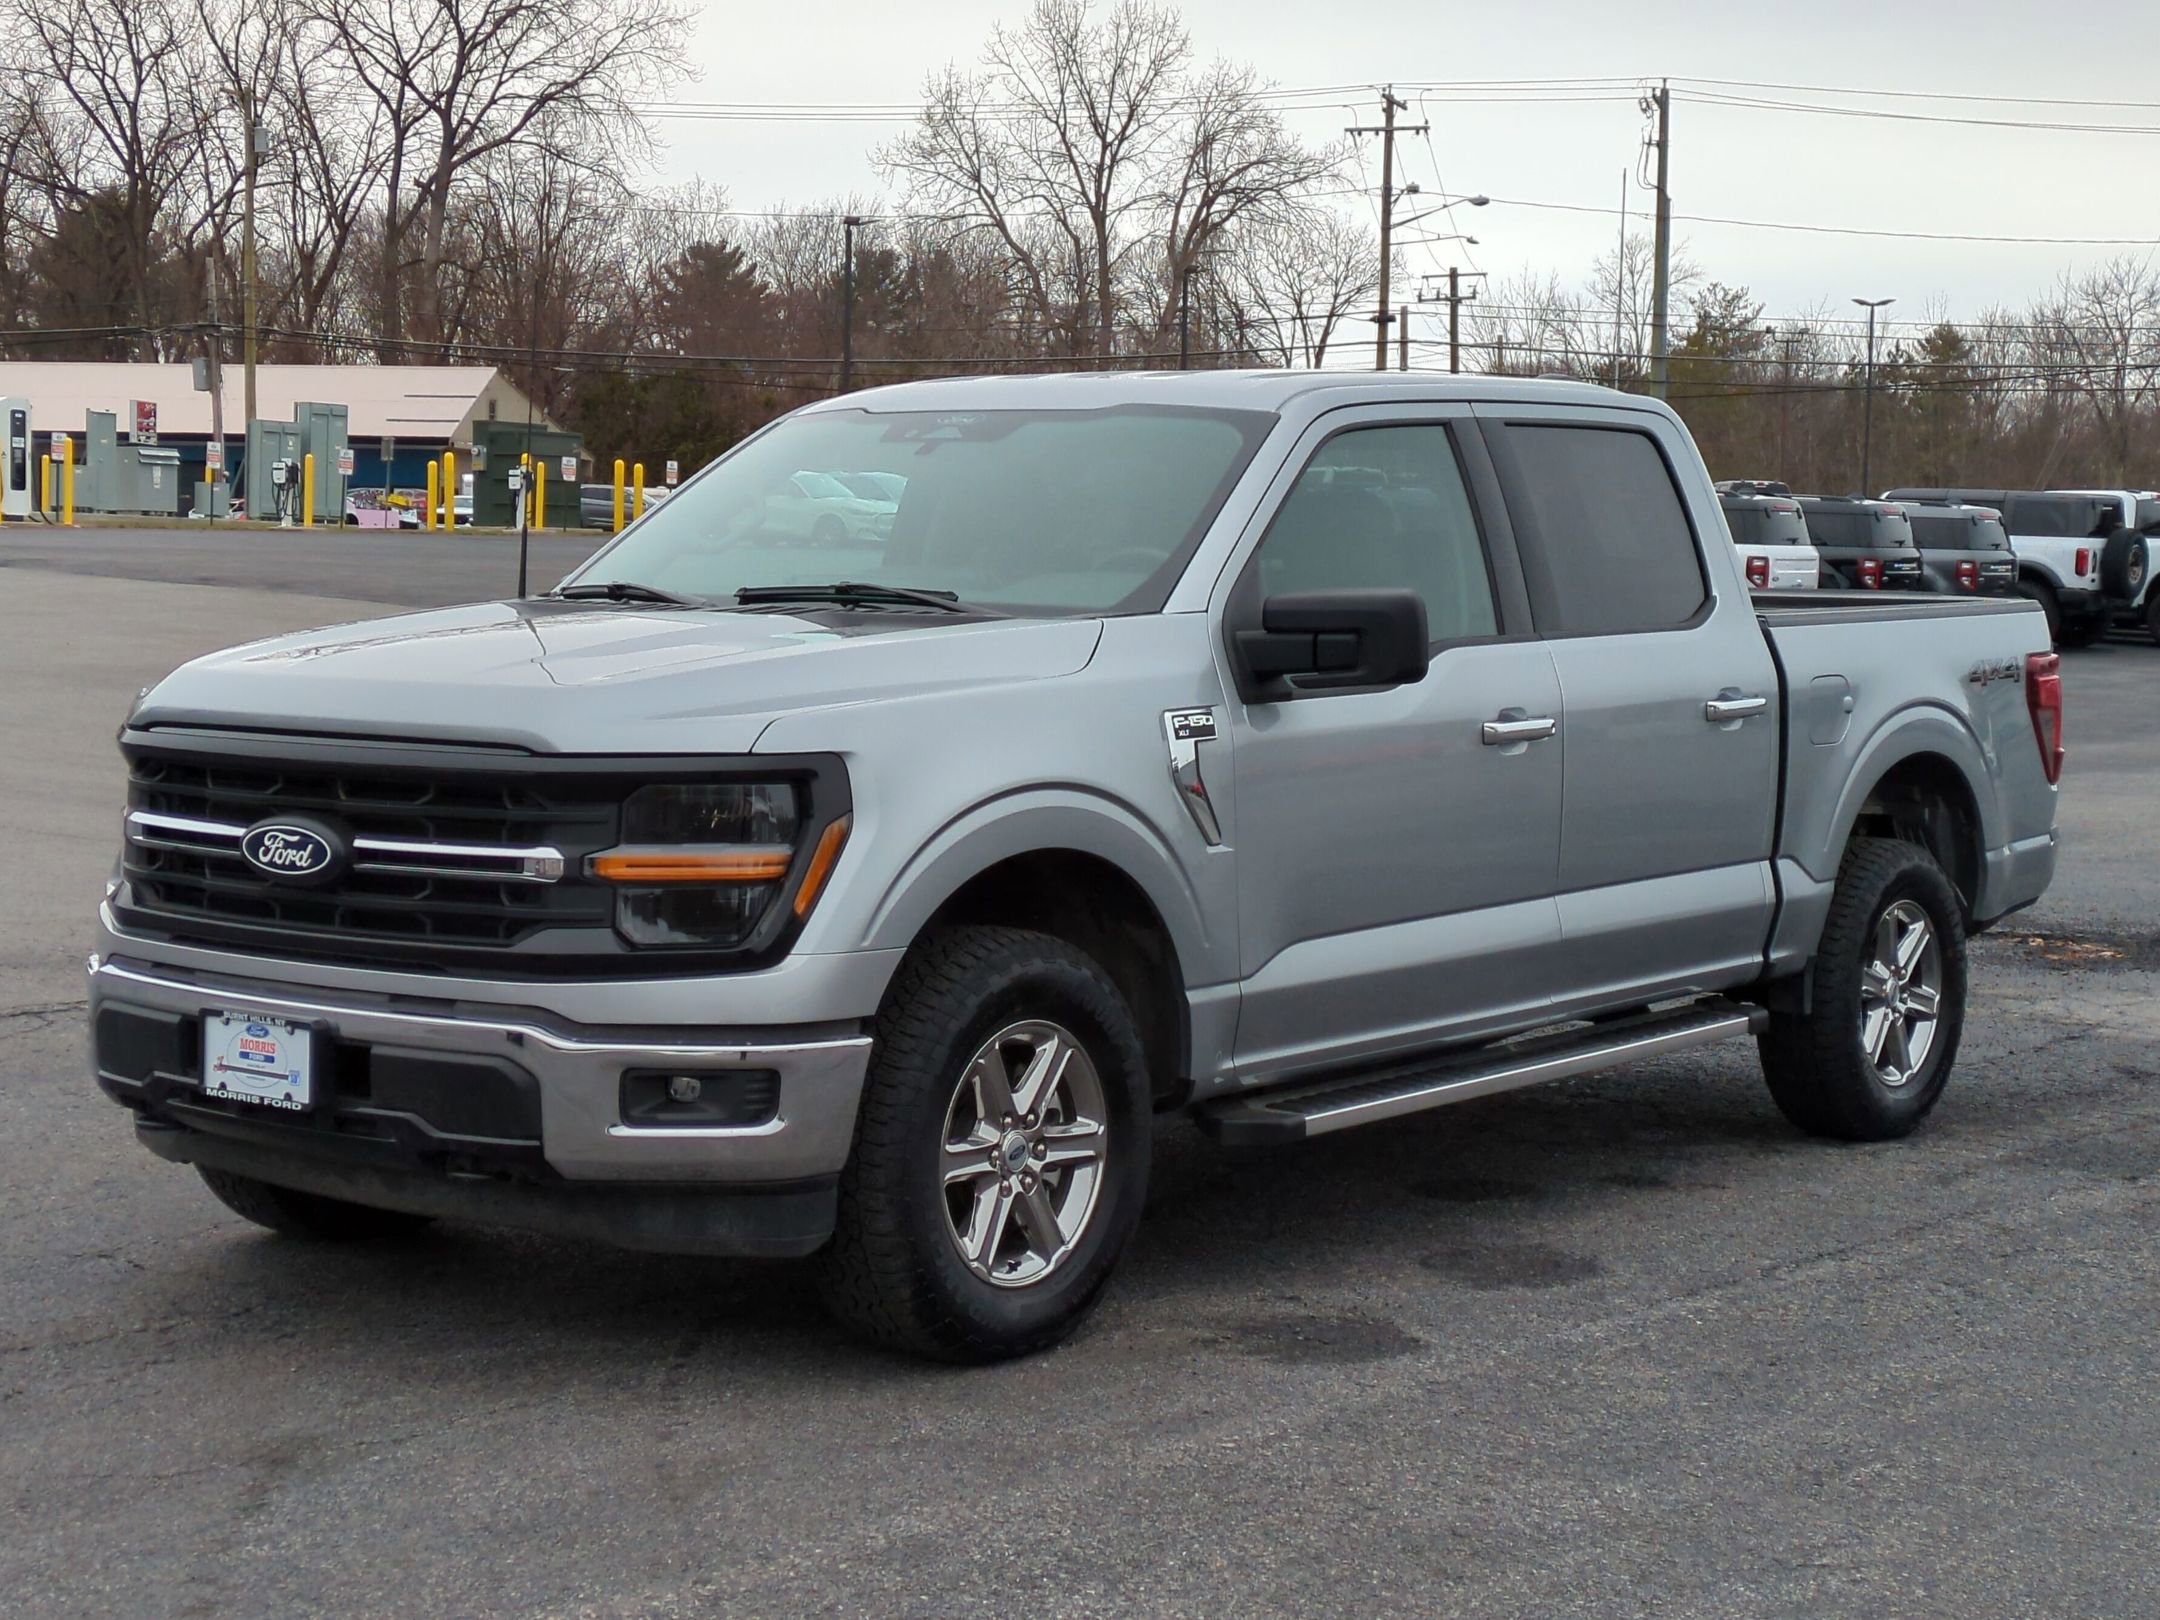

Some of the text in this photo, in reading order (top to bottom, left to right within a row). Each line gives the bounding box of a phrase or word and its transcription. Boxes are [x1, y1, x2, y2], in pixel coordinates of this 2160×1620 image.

[1173, 715, 1214, 728] F-150
[258, 831, 314, 868] Ford
[240, 1038, 276, 1054] MORRIS
[206, 1088, 302, 1111] MORRIS FORD
